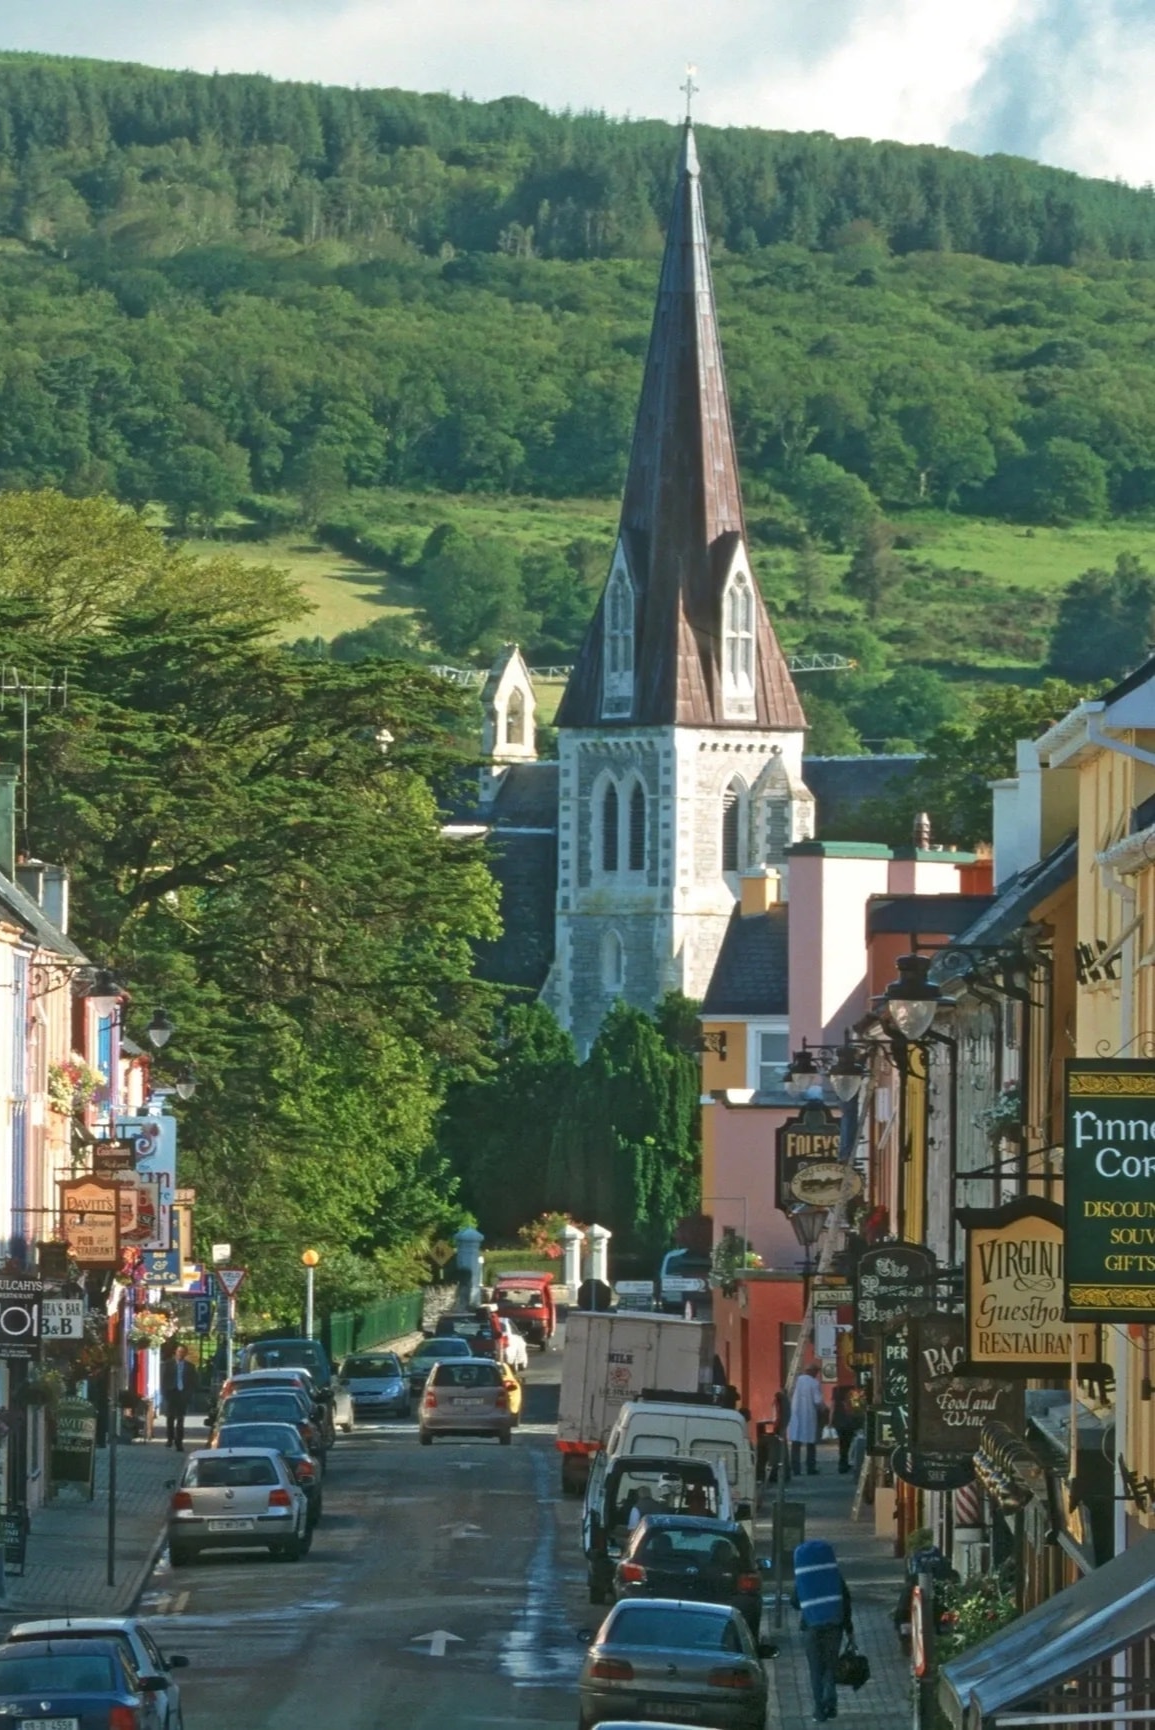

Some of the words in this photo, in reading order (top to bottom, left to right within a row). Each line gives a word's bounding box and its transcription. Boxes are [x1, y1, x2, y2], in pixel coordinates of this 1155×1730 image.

[977, 1239, 1064, 1289] VIRGINI
[65, 1302, 81, 1316] BAR
[197, 1303, 208, 1321] P
[975, 1294, 1064, 1329] Guestho
[886, 1346, 909, 1360] PER
[923, 1346, 964, 1378] PAC
[936, 1388, 976, 1410] Food
[971, 1388, 1003, 1411] and
[943, 1411, 986, 1427] Wine
